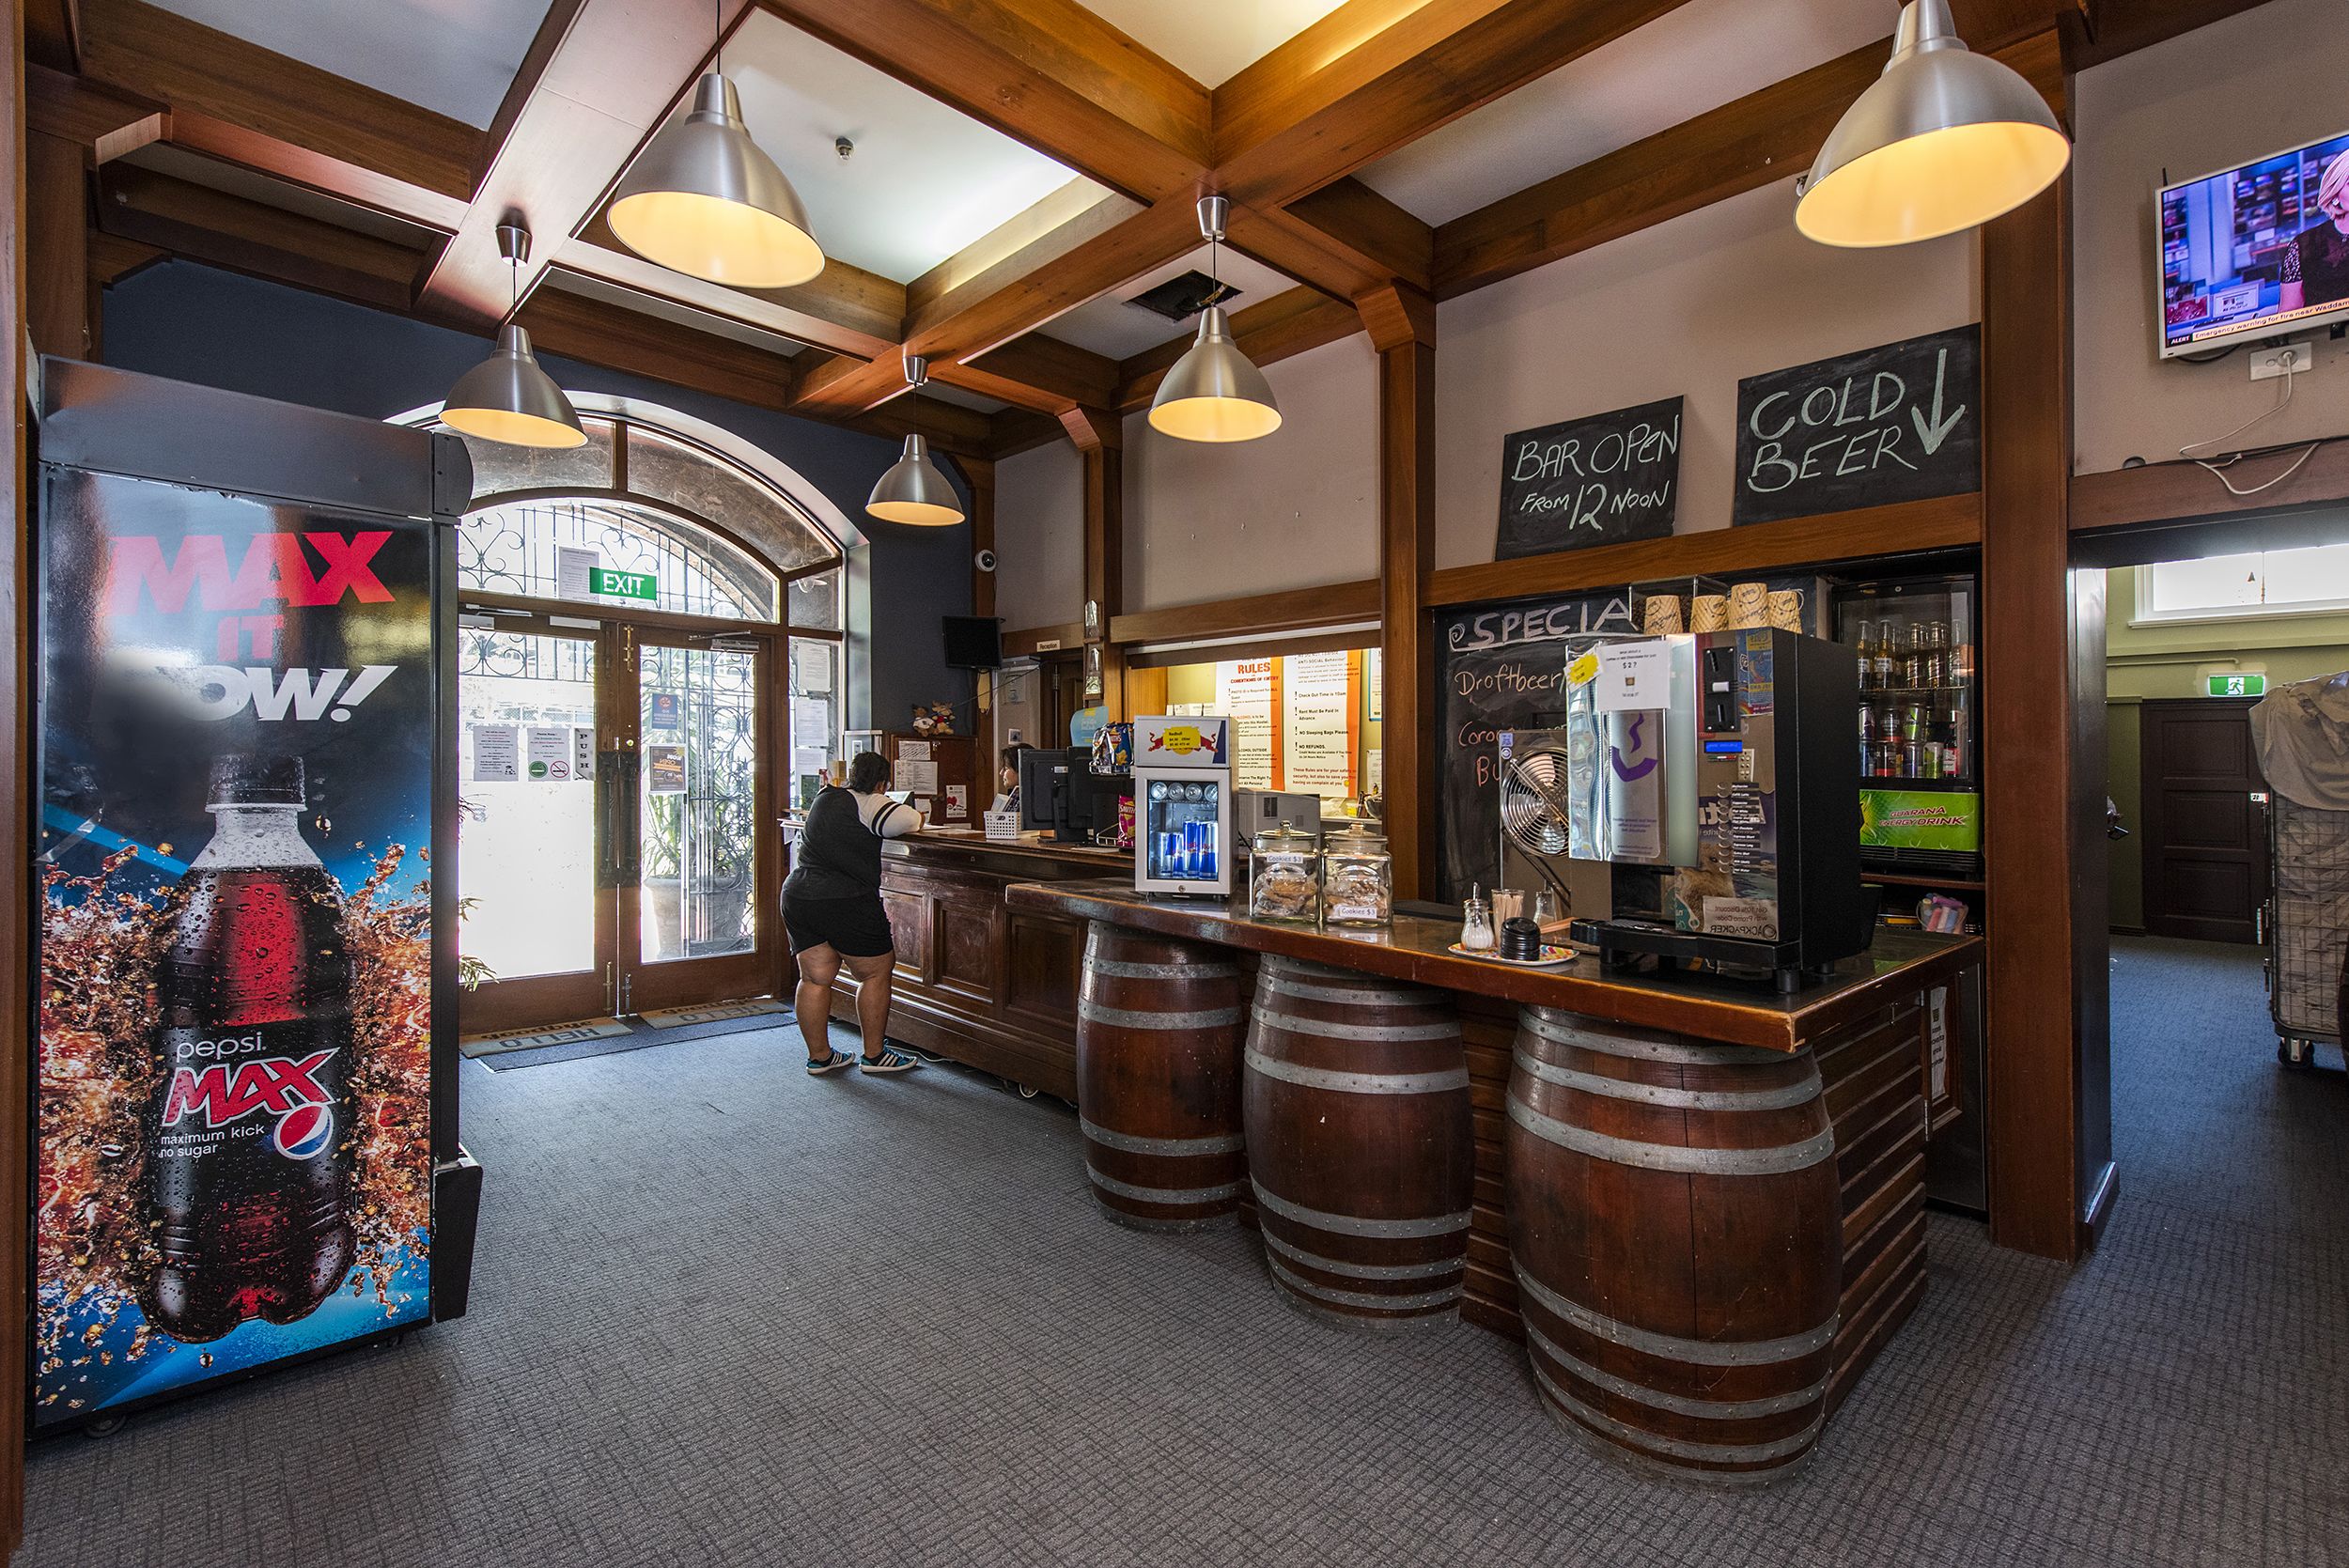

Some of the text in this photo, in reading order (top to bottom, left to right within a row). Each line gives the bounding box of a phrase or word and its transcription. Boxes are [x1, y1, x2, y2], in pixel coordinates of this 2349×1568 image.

[2171, 334, 2190, 344] ALERT
[2195, 326, 2234, 339] Emergency
[2236, 318, 2266, 331] warning
[2267, 315, 2279, 323] for
[2280, 312, 2295, 320] fire
[2295, 308, 2313, 317] near
[1750, 372, 1906, 440] COLD
[1512, 439, 1585, 482] BAR
[1748, 426, 1918, 493] BEER
[1520, 480, 1670, 532] FROM 12 NOON
[103, 531, 396, 615] MAX
[602, 572, 646, 596] EXIT
[217, 613, 285, 662] IT
[1468, 598, 1639, 647] SPECIA
[1237, 662, 1271, 675] RULES
[578, 733, 589, 768] PUSH
[1879, 815, 1968, 827] ENERGY DRINK
[1890, 805, 1947, 817] GUARANA
[176, 1031, 263, 1063] pepsi
[499, 1028, 602, 1048] HELLO
[162, 1047, 341, 1127] MAX
[161, 1124, 266, 1145] maximum kick
[161, 1142, 219, 1158] no sugar
